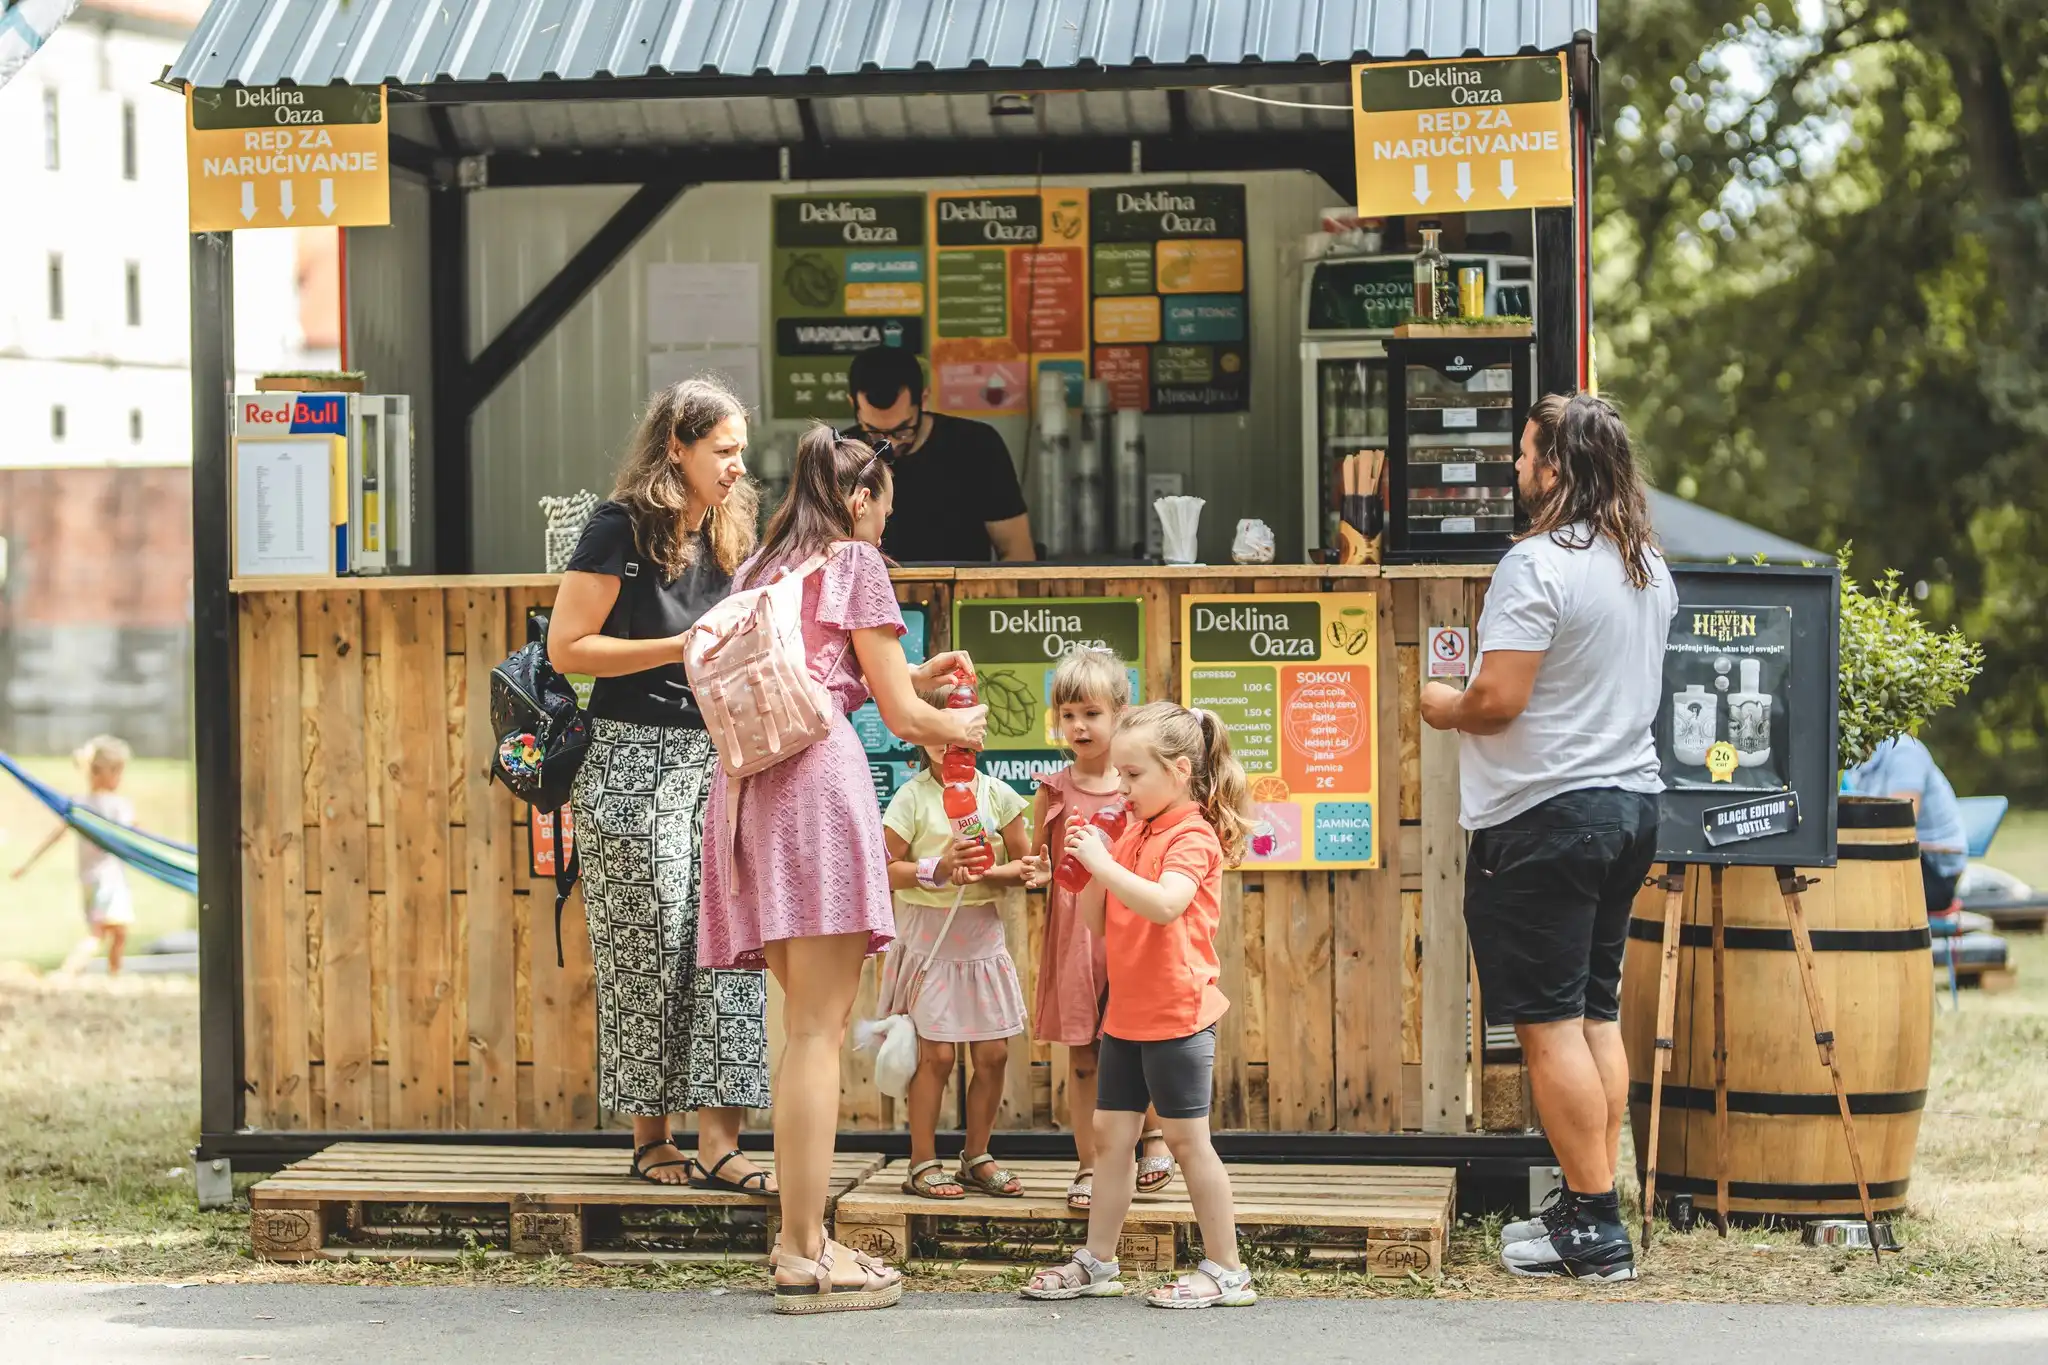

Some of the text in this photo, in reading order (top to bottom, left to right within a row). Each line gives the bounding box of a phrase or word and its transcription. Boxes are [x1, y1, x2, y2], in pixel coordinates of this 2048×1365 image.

[1408, 67, 1482, 88] Deklina
[236, 88, 304, 107] Deklina
[1451, 86, 1502, 104] Oaza
[275, 106, 323, 123] Oaza
[1418, 109, 1512, 132] RED ZA
[245, 129, 333, 150] RED ZA
[1373, 131, 1559, 160] NARUČIVANJE
[203, 150, 378, 176] NARUČIVANJE
[941, 201, 1017, 220] Deklina
[1116, 190, 1195, 213] Deklina
[800, 202, 877, 222] Deklina
[983, 221, 1038, 240] Oaza
[1161, 212, 1216, 232] Oaza
[843, 222, 898, 241] Oaza
[1354, 283, 1413, 295] POZOVI
[796, 326, 881, 342] VARIONICA
[246, 402, 338, 423] Red Bull
[990, 609, 1082, 634] Deklina
[1196, 607, 1290, 632] Deklina
[1250, 632, 1315, 656] Oaza
[1193, 671, 1236, 679] ESPRESSO
[1296, 672, 1351, 683] SOKOVI
[1243, 683, 1273, 692] 1.00 €
[1303, 687, 1345, 696] coca cola
[1193, 697, 1248, 705] CAPPUCCINO
[1292, 701, 1313, 709] coca
[1315, 700, 1335, 709] cola
[1244, 708, 1272, 717] 1.50 €
[1312, 713, 1336, 721] fanta
[1244, 735, 1272, 744] 1.50 €
[1311, 726, 1337, 736] sprite
[1314, 751, 1335, 761] jana
[1715, 750, 1730, 761] 26
[1264, 761, 1273, 769] €
[1306, 763, 1343, 774] jamnica
[1316, 776, 1335, 788] 2€
[957, 814, 980, 830] Jana
[1717, 801, 1786, 826] BLACK EDITION
[1316, 818, 1370, 829] JAMNICA
[1736, 818, 1772, 836] BOTTLE
[268, 1219, 303, 1237] EPAL
[1385, 1250, 1422, 1268] EPAL
